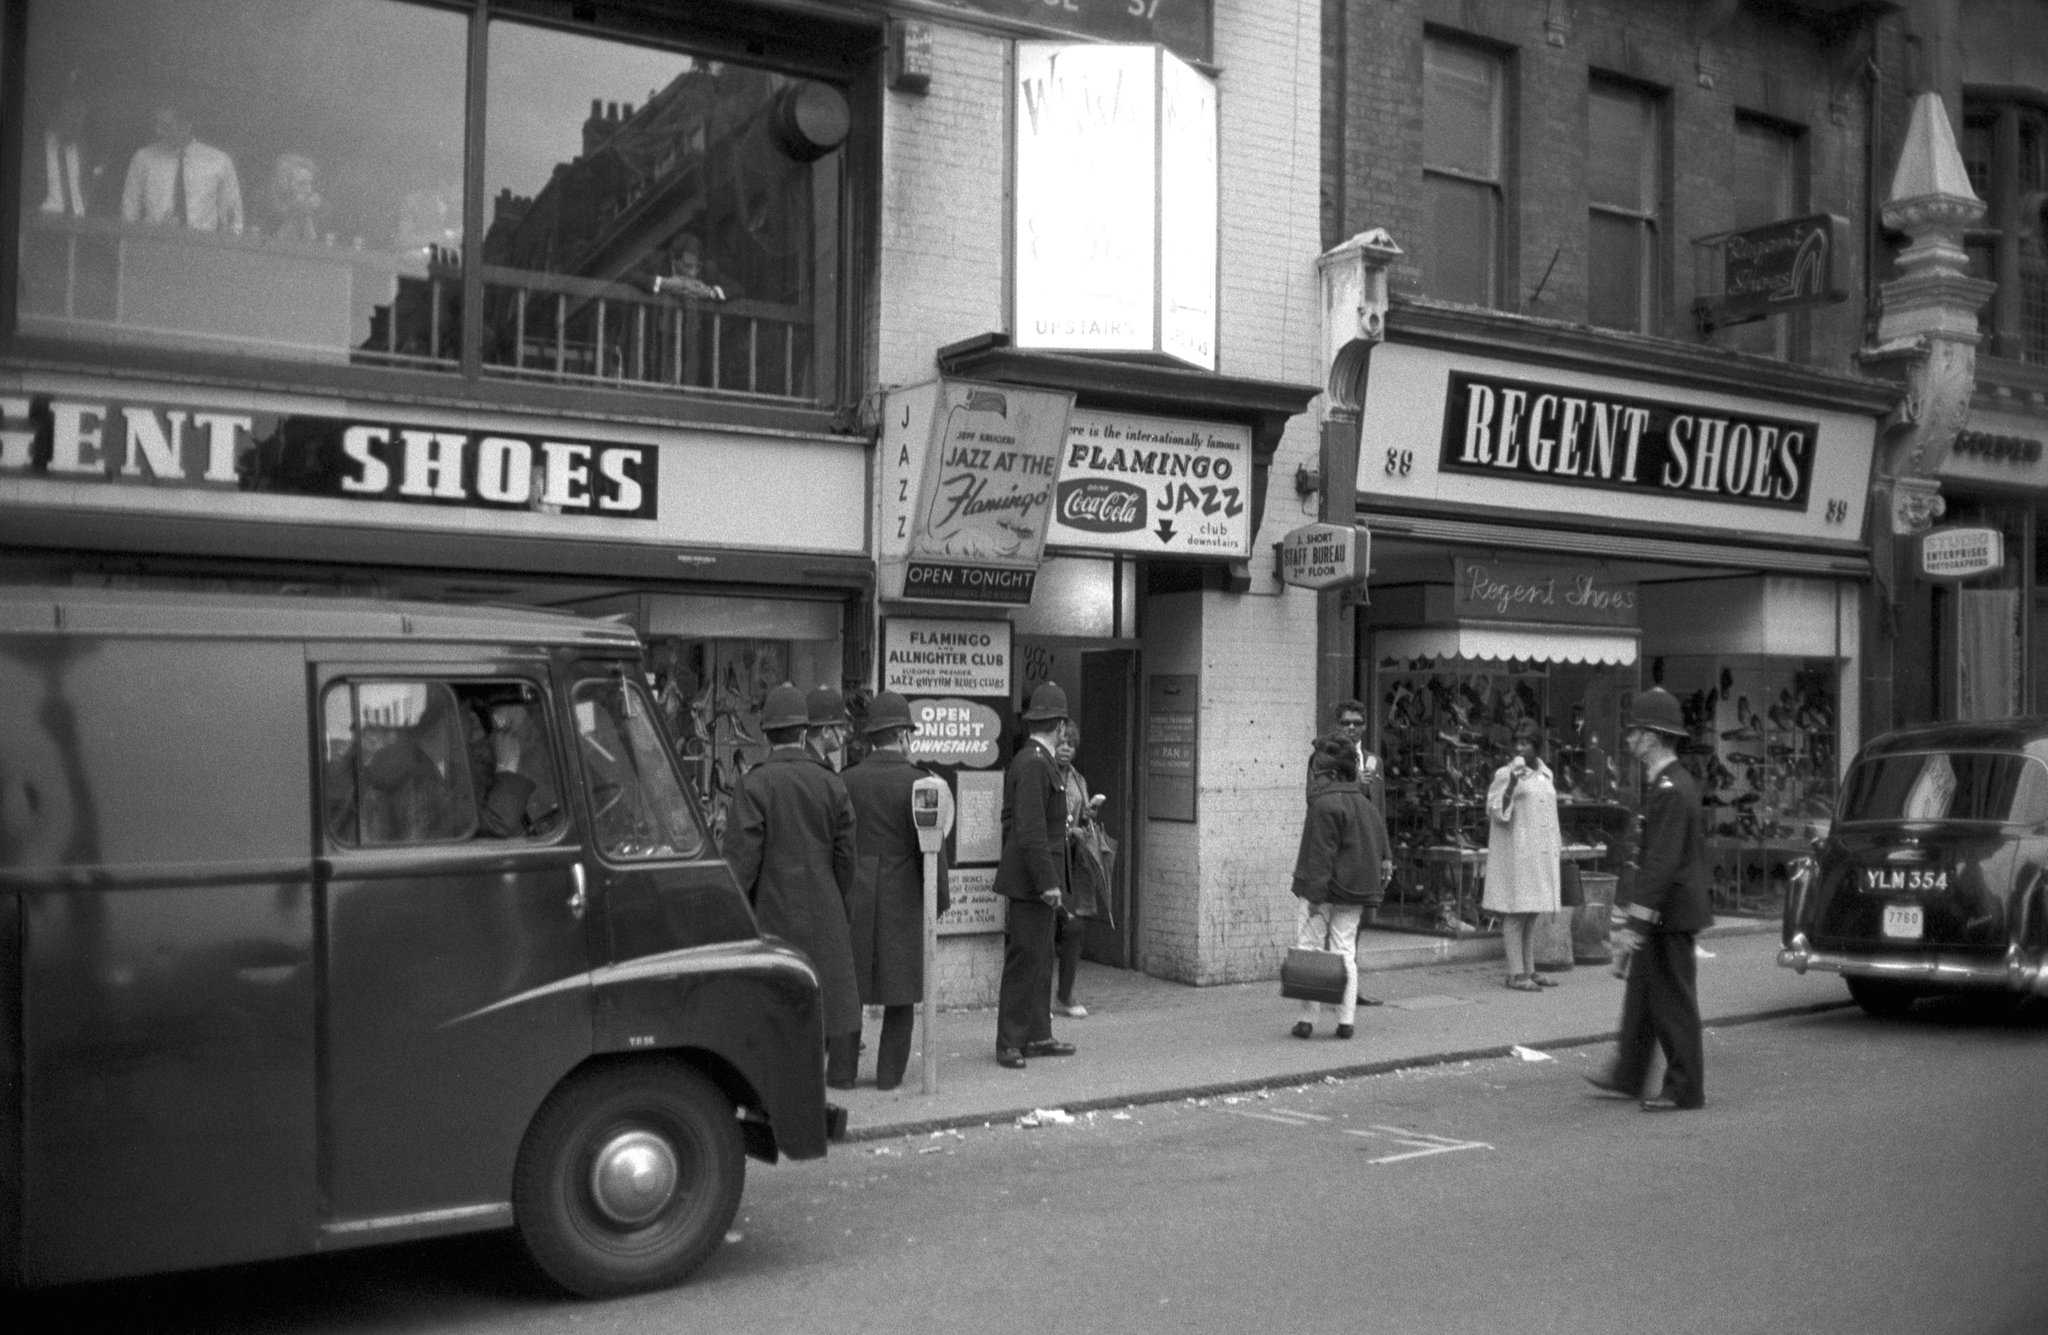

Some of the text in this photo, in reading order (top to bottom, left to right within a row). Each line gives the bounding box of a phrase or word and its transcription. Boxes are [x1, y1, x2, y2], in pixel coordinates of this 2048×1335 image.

[1089, 422, 1099, 437] is
[1104, 424, 1121, 440] the
[1126, 425, 1204, 451] internationally
[1207, 434, 1241, 451] famous
[1460, 384, 1804, 500] REGENT SHOES
[342, 425, 642, 513] SHOES
[946, 447, 1055, 477] JAZZ AT THE
[1068, 444, 1233, 480] FLAMINGO
[1156, 481, 1244, 519] JAZZ
[1200, 522, 1228, 536] club
[1187, 535, 1238, 548] downstairs
[1307, 532, 1334, 545] SHORT
[1284, 544, 1346, 567] STAFF BUREAU
[1926, 547, 1988, 561] ENTERPRISES
[909, 567, 1033, 587] OPEN TONIGHT
[1308, 566, 1336, 577] FLOOR
[1467, 564, 1635, 614] Regent Shoes
[909, 631, 992, 647] FLAMINGO
[889, 650, 1004, 667] ALLNIGHTER CLUB
[890, 675, 1005, 689] JAZZ RHYTHM BLUES CLUBS
[921, 707, 971, 722] OPEN
[913, 722, 984, 737] ONIGHT
[910, 740, 989, 754] OWNSTAIRS
[1867, 870, 1948, 890] YLM 354
